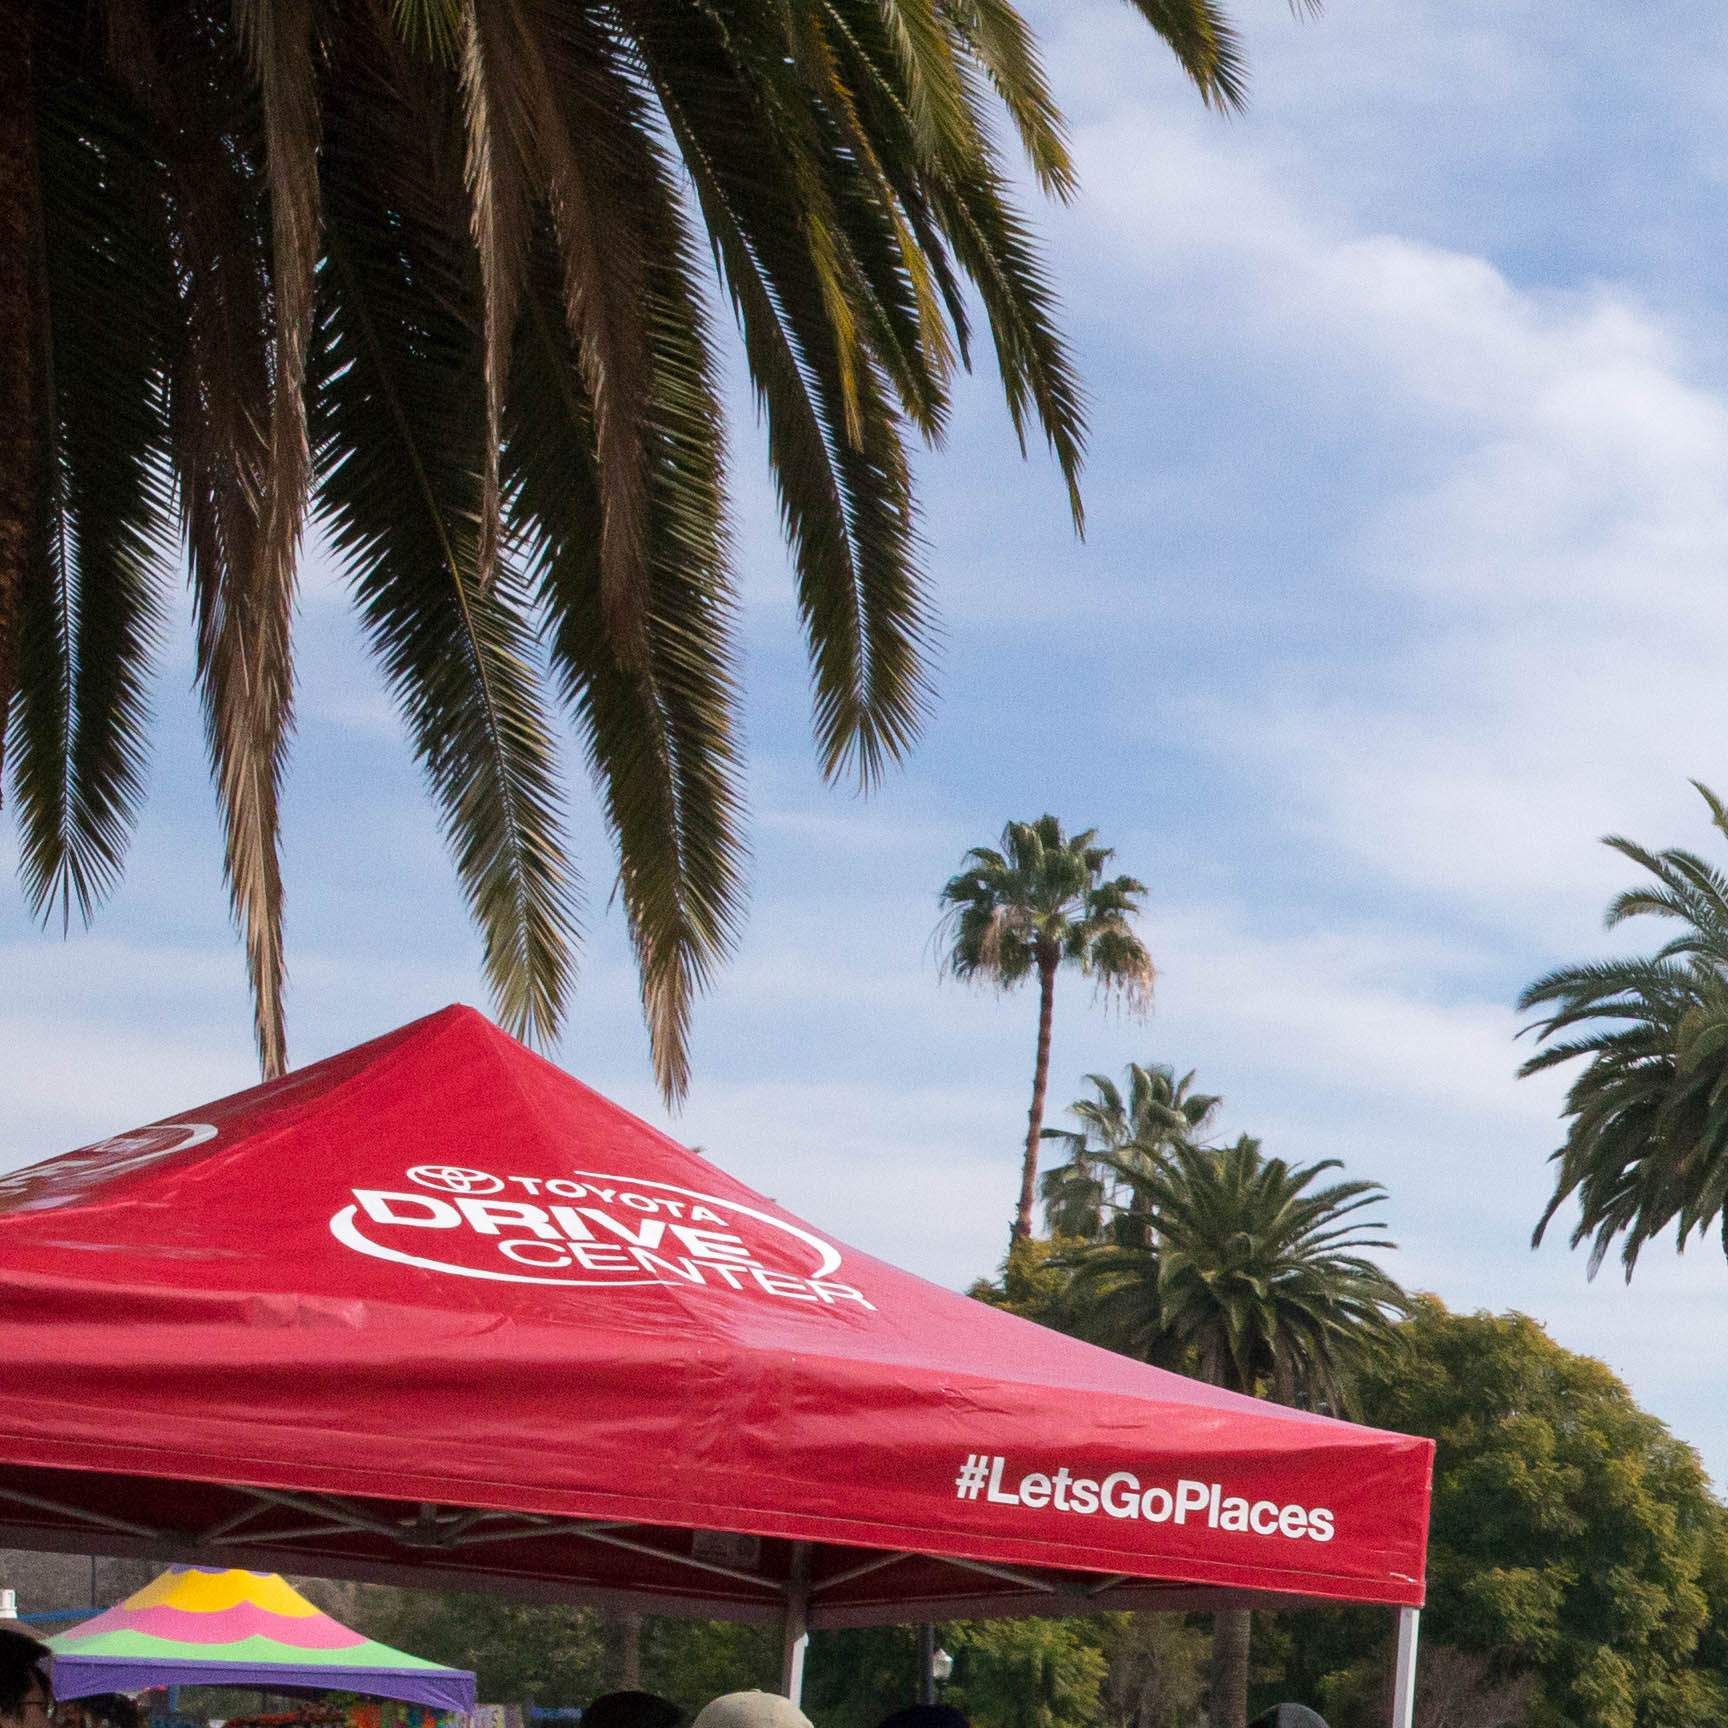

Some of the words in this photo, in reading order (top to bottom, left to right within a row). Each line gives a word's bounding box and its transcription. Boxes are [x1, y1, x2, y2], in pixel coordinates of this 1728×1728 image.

[351, 1188, 763, 1269] DRIVE
[508, 1176, 729, 1226] TOYOTA
[498, 1238, 879, 1311] CENTER
[955, 1453, 1335, 1542] #LetsGoPlaces
